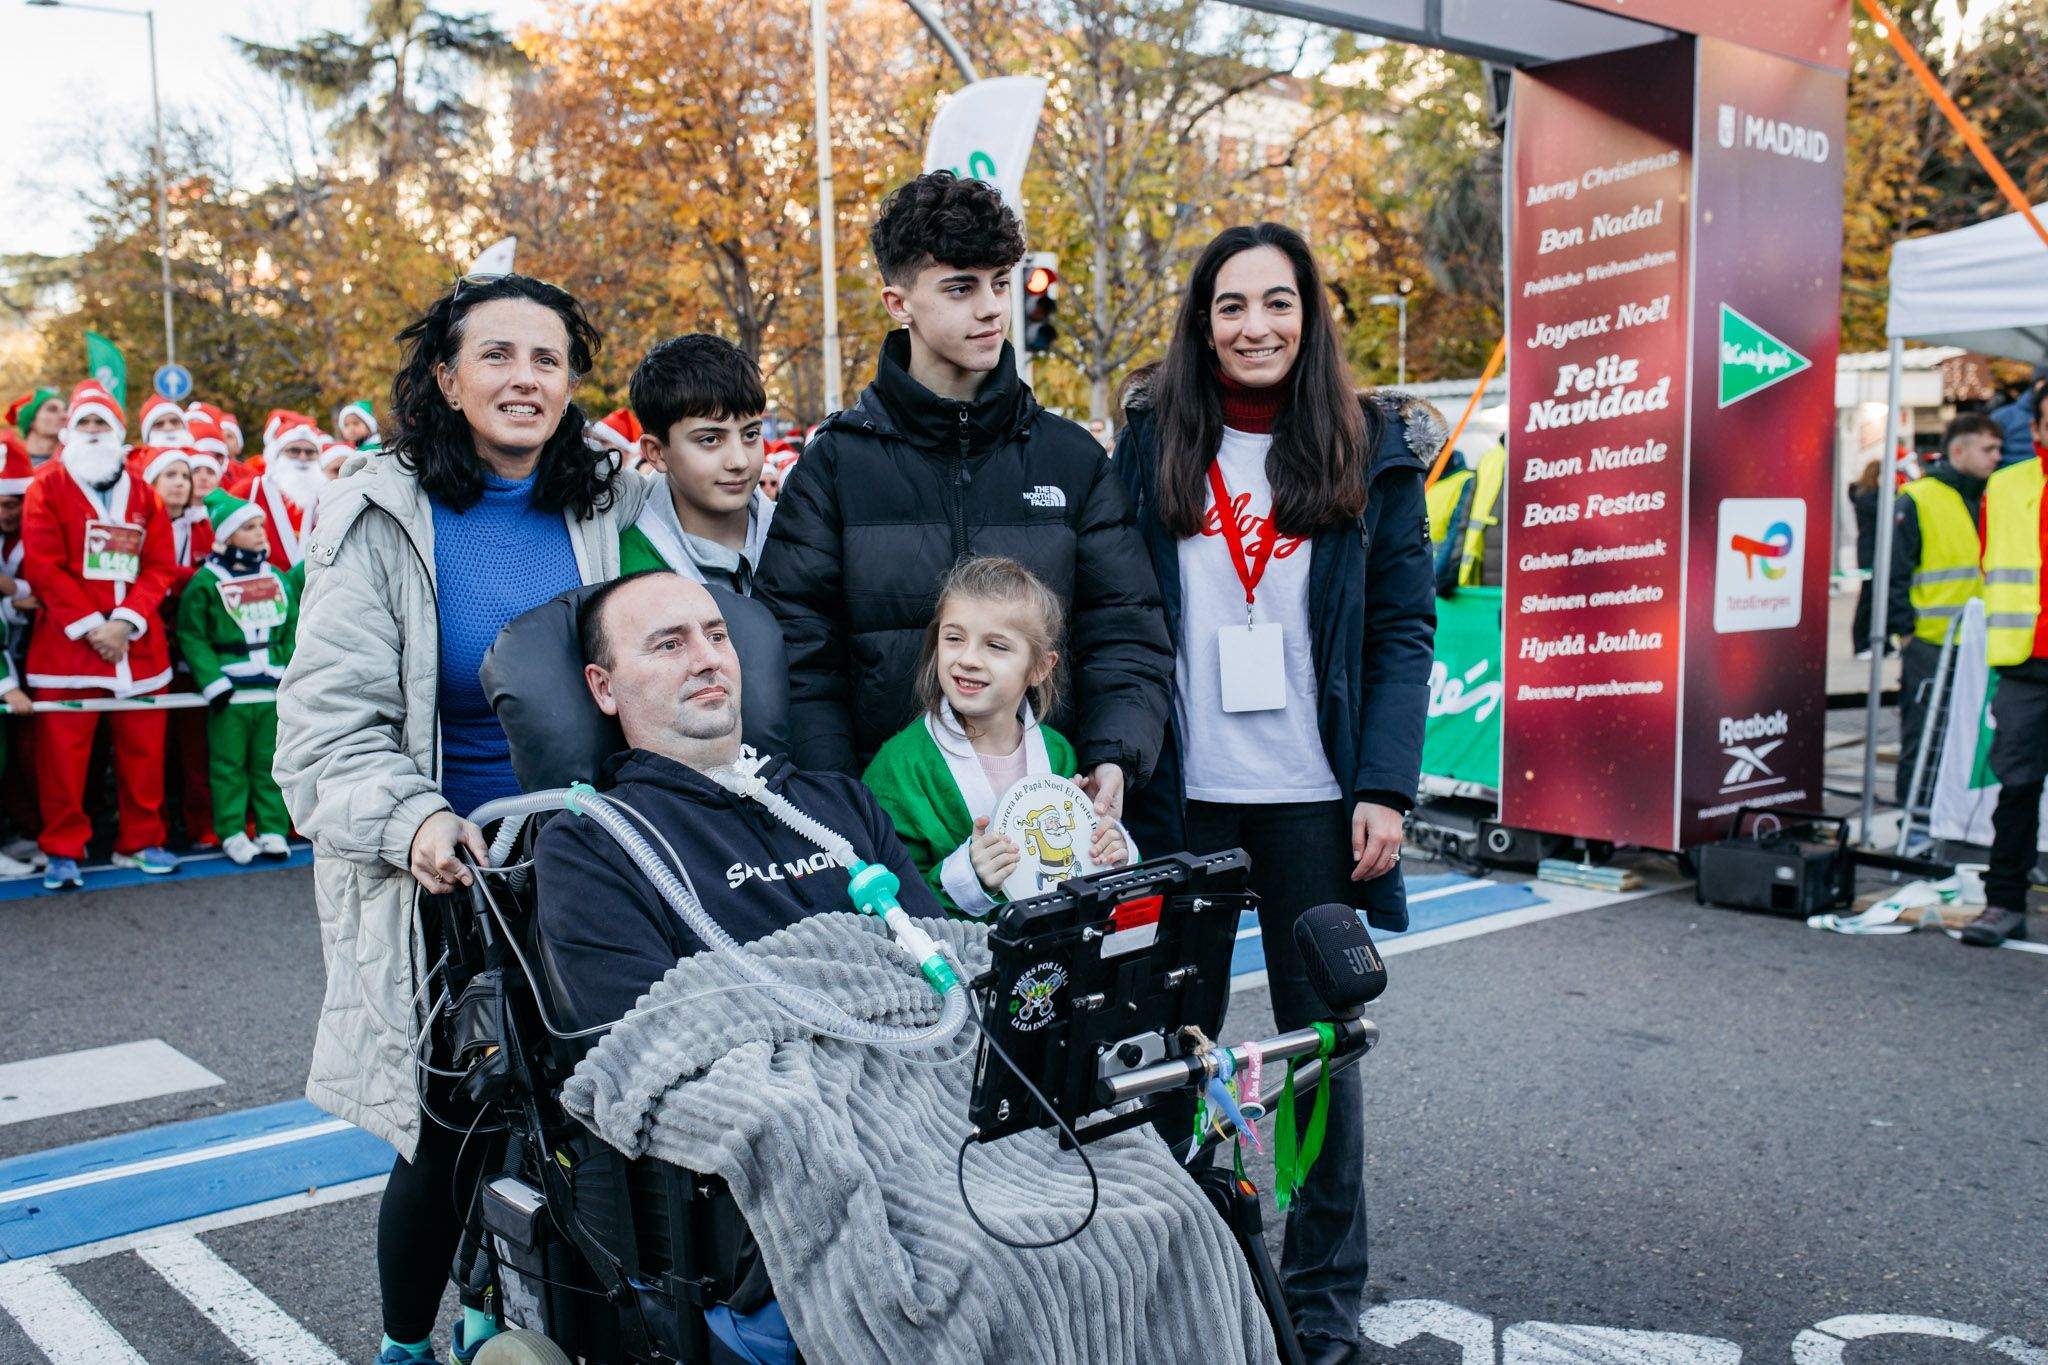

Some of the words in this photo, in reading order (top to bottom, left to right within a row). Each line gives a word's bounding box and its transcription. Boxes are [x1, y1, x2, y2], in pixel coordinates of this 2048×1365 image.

[1745, 114, 1829, 163] MADRID
[1526, 178, 1579, 207] Merry
[1581, 150, 1680, 190] Christmas
[1538, 227, 1584, 255] Bon
[1589, 198, 1664, 242] Nadal
[1526, 314, 1612, 349] Joyeux
[1615, 294, 1671, 331] Noël
[1553, 353, 1640, 397] Feliz
[1524, 376, 1671, 434] Navidad
[1522, 456, 1583, 483] Buon
[1587, 438, 1668, 473] Natale
[1022, 492, 1050, 500] NORTH
[1031, 499, 1050, 507] FACE
[1033, 485, 1050, 493] THE
[1521, 502, 1580, 528] Boas
[1584, 490, 1666, 520] Festas
[1520, 594, 1587, 614] Shinnen
[1589, 584, 1664, 608] omedeto
[1588, 628, 1663, 654] Joulua
[1718, 709, 1789, 747] Reebok
[998, 801, 1016, 836] Carrera
[1015, 790, 1024, 802] de
[1044, 779, 1063, 792] Noel
[1065, 786, 1075, 798] El
[1075, 795, 1093, 820] Corte
[1011, 967, 1037, 996] BIKERS
[1038, 962, 1054, 971] POR
[1053, 963, 1063, 974] LA
[1342, 945, 1384, 975] JBL
[1011, 1017, 1020, 1029] LA
[1019, 1022, 1032, 1032] ELA
[1033, 1011, 1057, 1030] EXISTE
